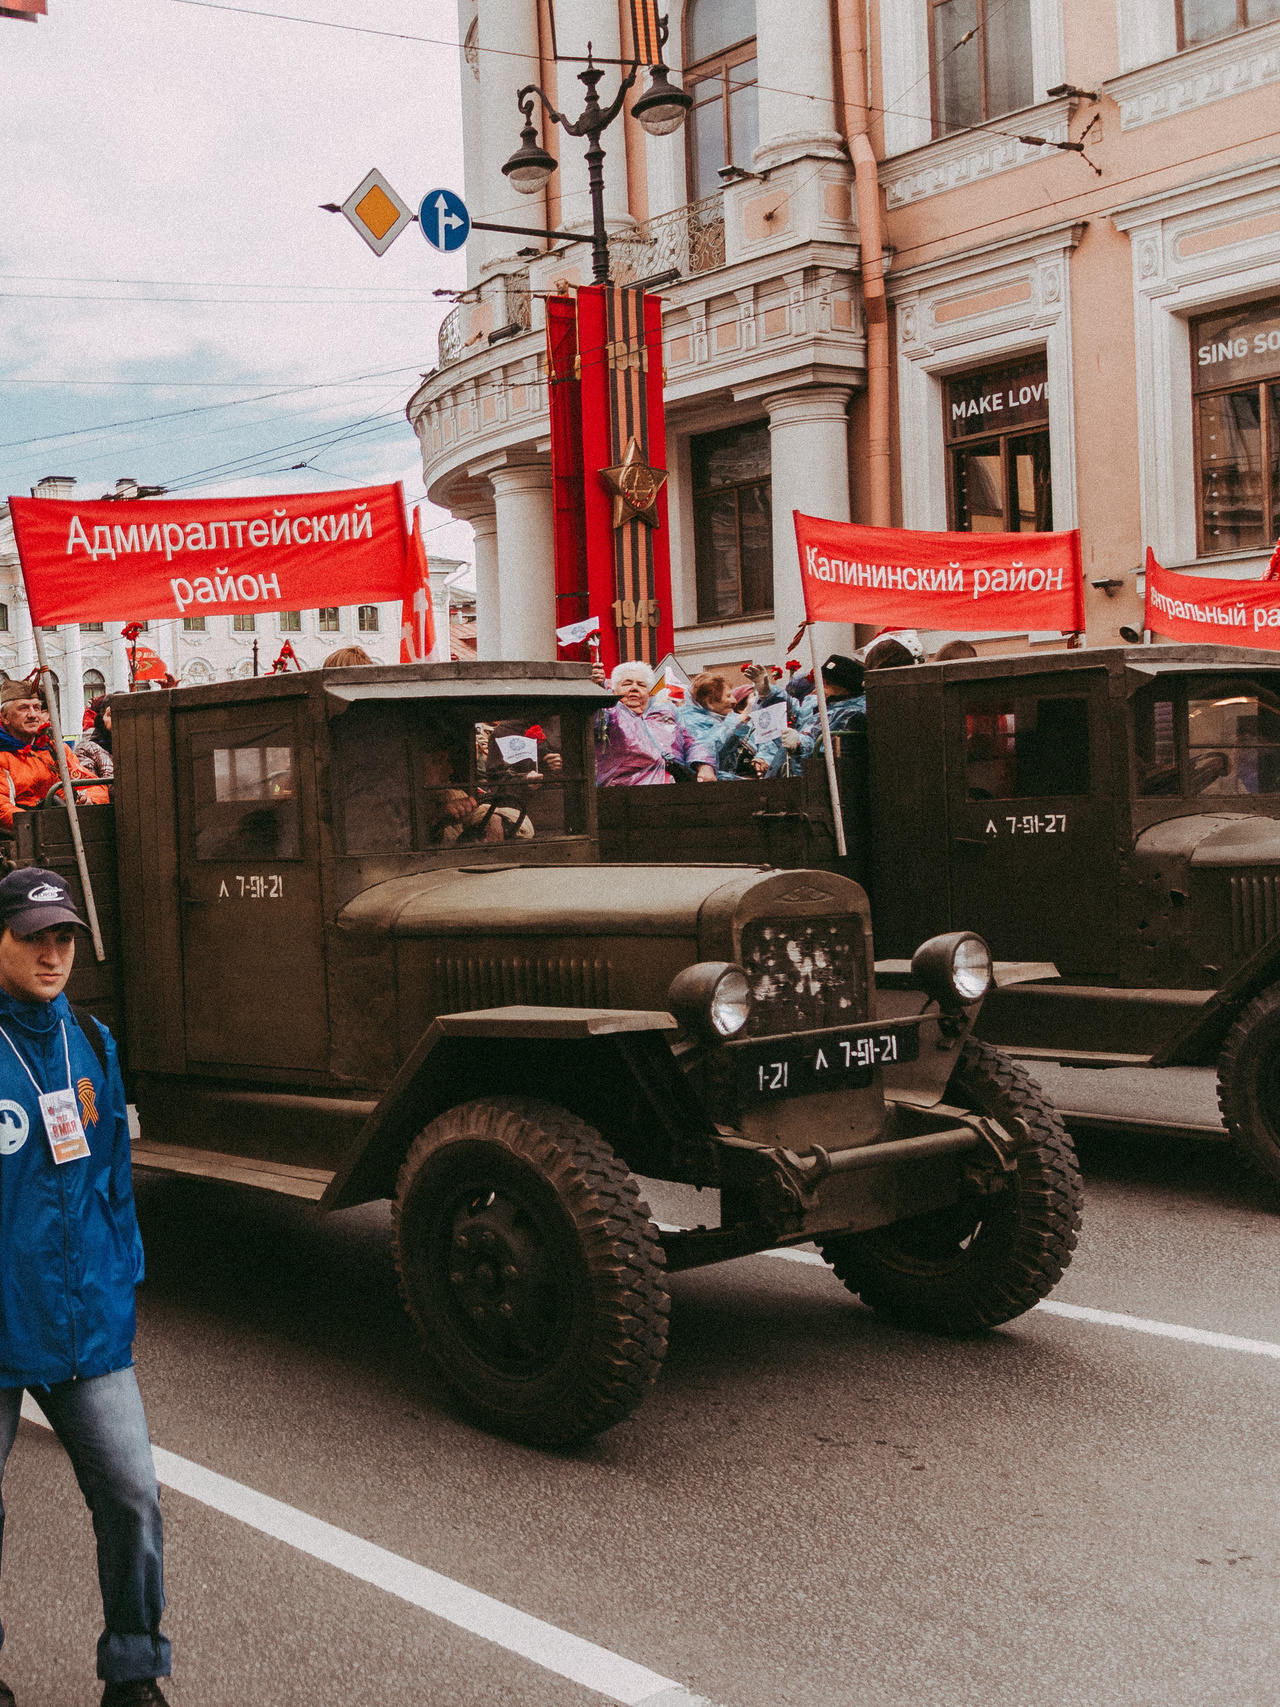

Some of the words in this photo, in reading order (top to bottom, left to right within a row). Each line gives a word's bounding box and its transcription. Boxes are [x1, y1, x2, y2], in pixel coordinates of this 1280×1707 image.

[605, 341, 649, 373] 1941
[1198, 337, 1248, 366] SING
[952, 392, 1003, 421] MAKE
[66, 502, 373, 562] Адмиралтейский
[805, 545, 964, 592] Калининский
[973, 561, 1064, 600] район
[170, 566, 282, 613] район
[1150, 585, 1247, 626] ентральный
[611, 598, 662, 628] 1945
[1005, 814, 1066, 834] 7-91-27
[236, 874, 283, 898] 7-91-21
[839, 1034, 898, 1068] 7-91-21
